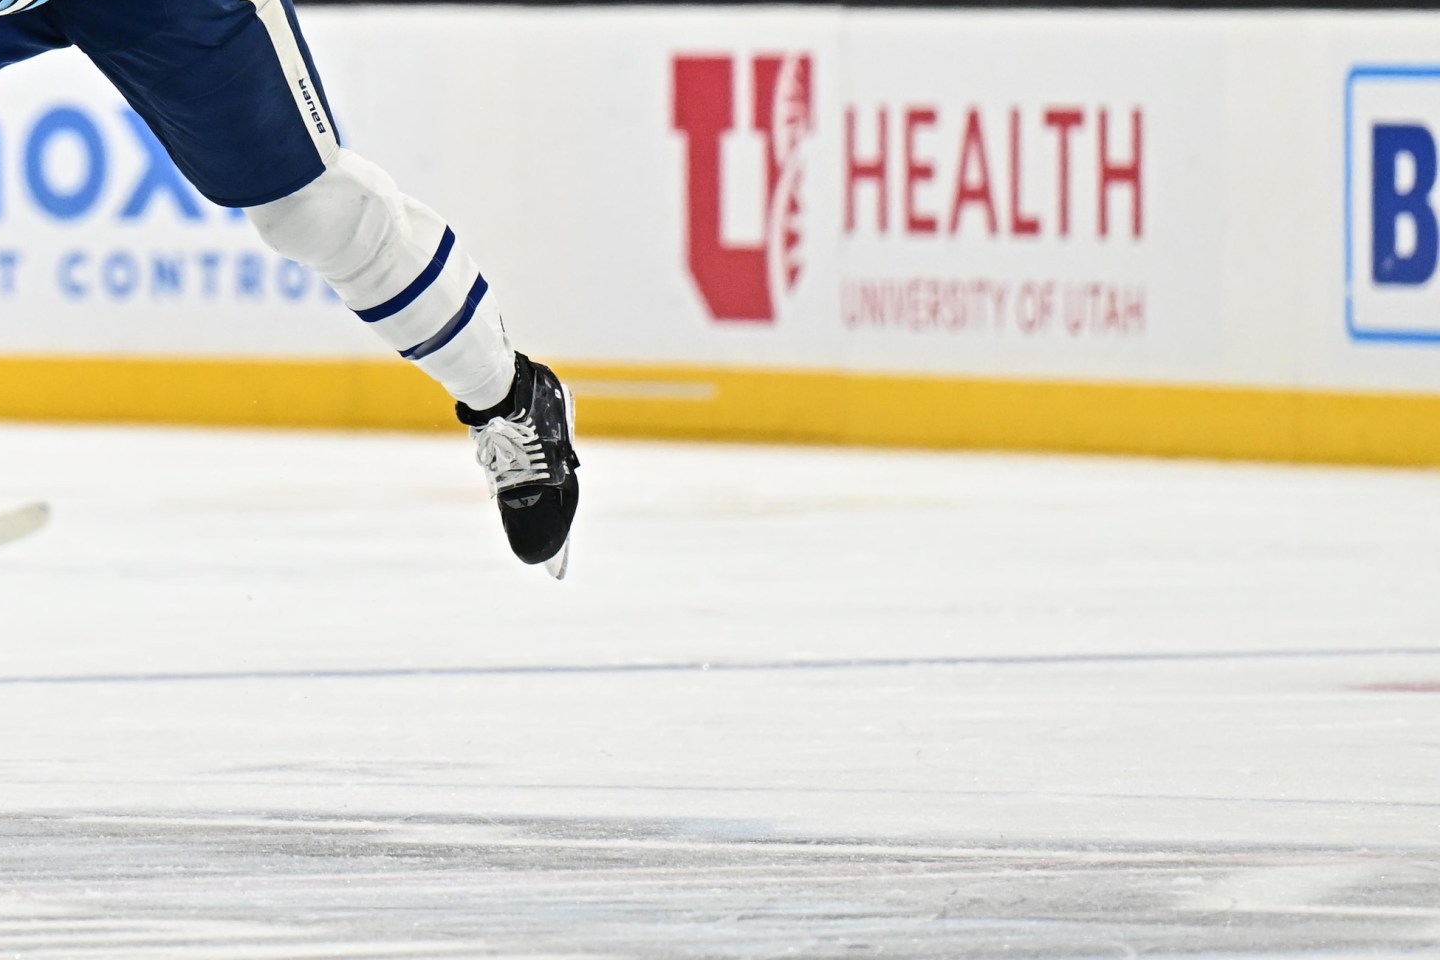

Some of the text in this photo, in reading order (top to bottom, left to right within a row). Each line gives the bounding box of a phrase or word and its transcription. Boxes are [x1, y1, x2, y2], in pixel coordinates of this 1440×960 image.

[843, 106, 1144, 238] HEALTH
[56, 251, 344, 302] CONTRO
[841, 280, 1146, 334] UNIVERSITY OF UTAH
